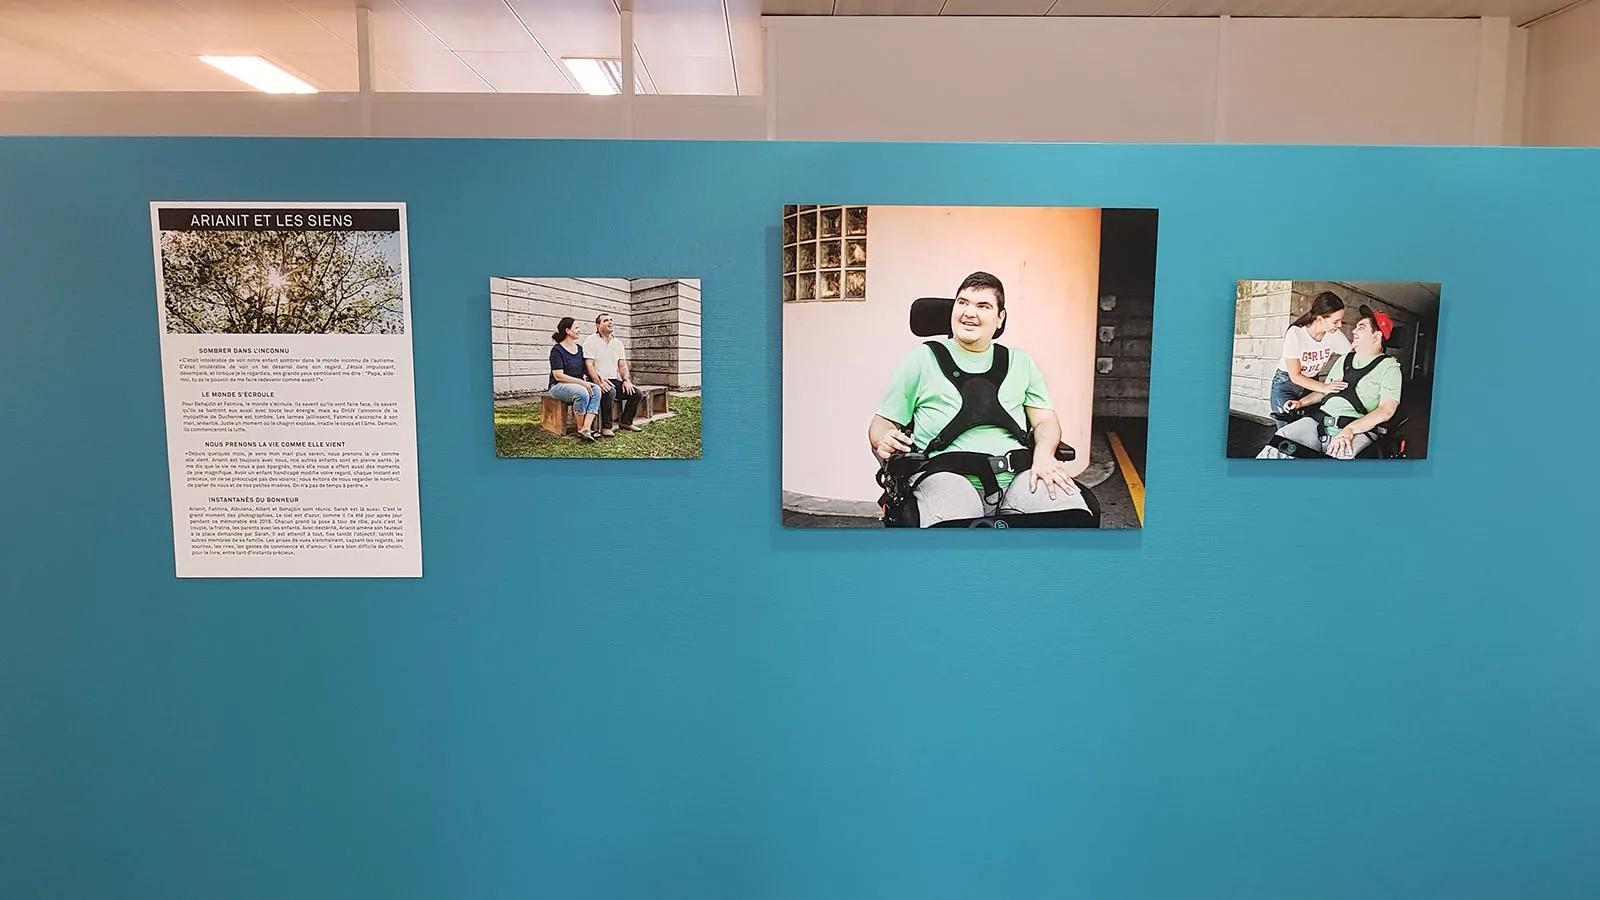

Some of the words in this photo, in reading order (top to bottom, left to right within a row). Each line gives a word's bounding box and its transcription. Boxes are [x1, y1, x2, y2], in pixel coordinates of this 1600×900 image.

[190, 214, 250, 227] ARIANIT
[254, 214, 272, 227] ET
[276, 214, 303, 227] LES
[307, 214, 353, 227] SIENS
[1302, 348, 1330, 362] GIRLS
